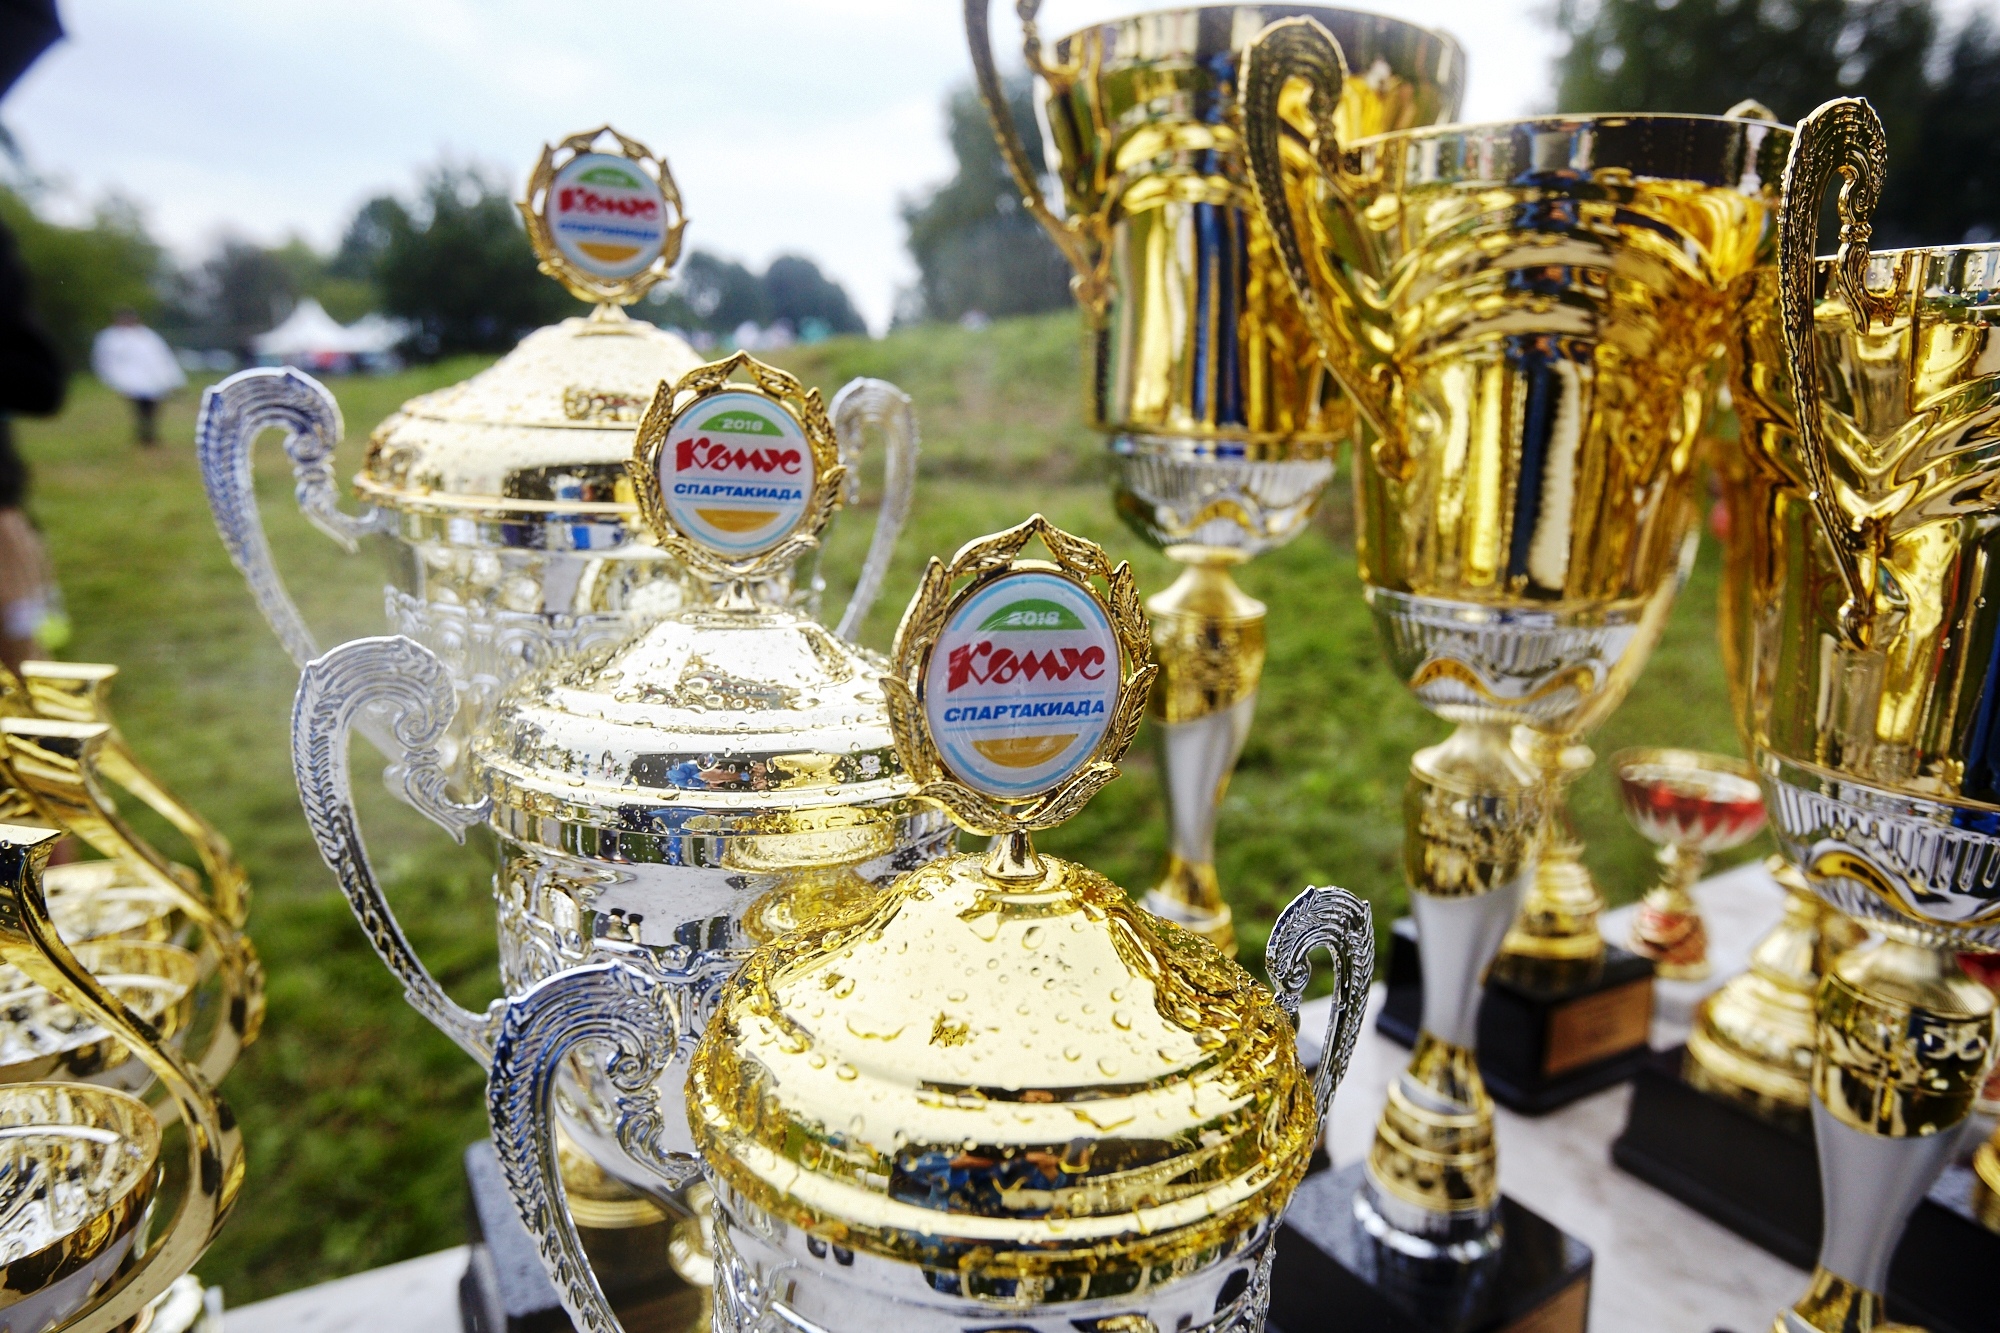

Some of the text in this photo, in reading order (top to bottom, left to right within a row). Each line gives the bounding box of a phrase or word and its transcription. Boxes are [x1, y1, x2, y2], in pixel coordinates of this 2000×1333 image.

[675, 437, 802, 475] Комус
[674, 483, 802, 500] СПАРТАКИАДА
[947, 640, 1106, 693] Комус
[944, 699, 1105, 723] СПАРТАКИАДА
